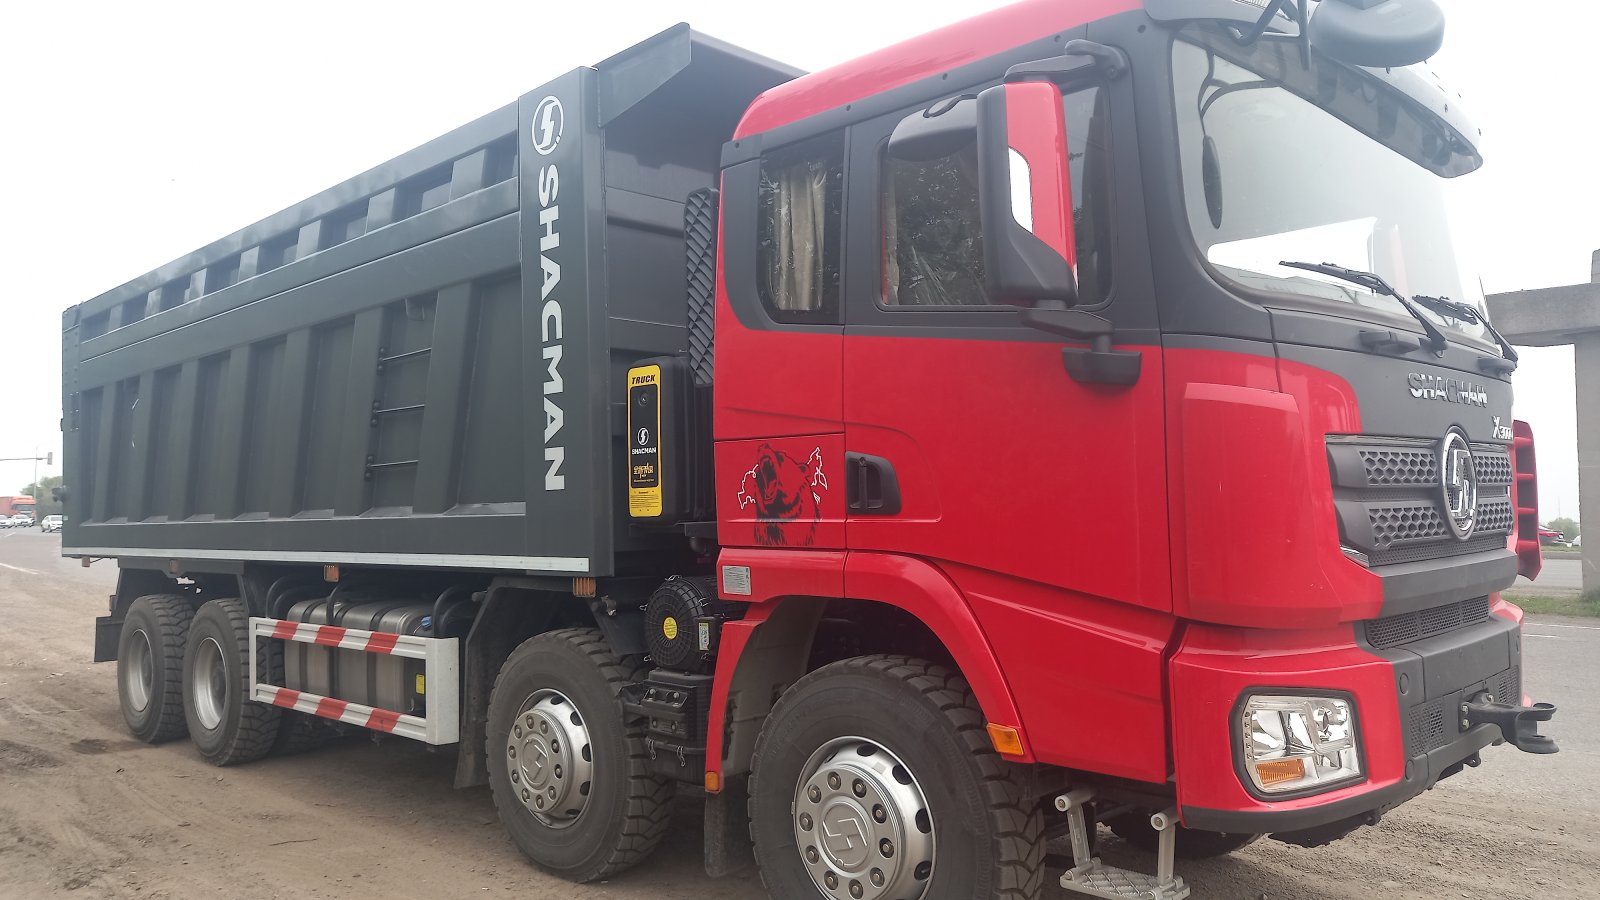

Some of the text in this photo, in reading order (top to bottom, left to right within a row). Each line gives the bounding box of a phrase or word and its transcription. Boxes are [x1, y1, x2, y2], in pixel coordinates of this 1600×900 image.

[538, 164, 565, 491] SHACMAN
[631, 374, 656, 385] TRUCK
[1408, 373, 1488, 408] SHACMAN
[631, 447, 657, 455] SHACMAN
